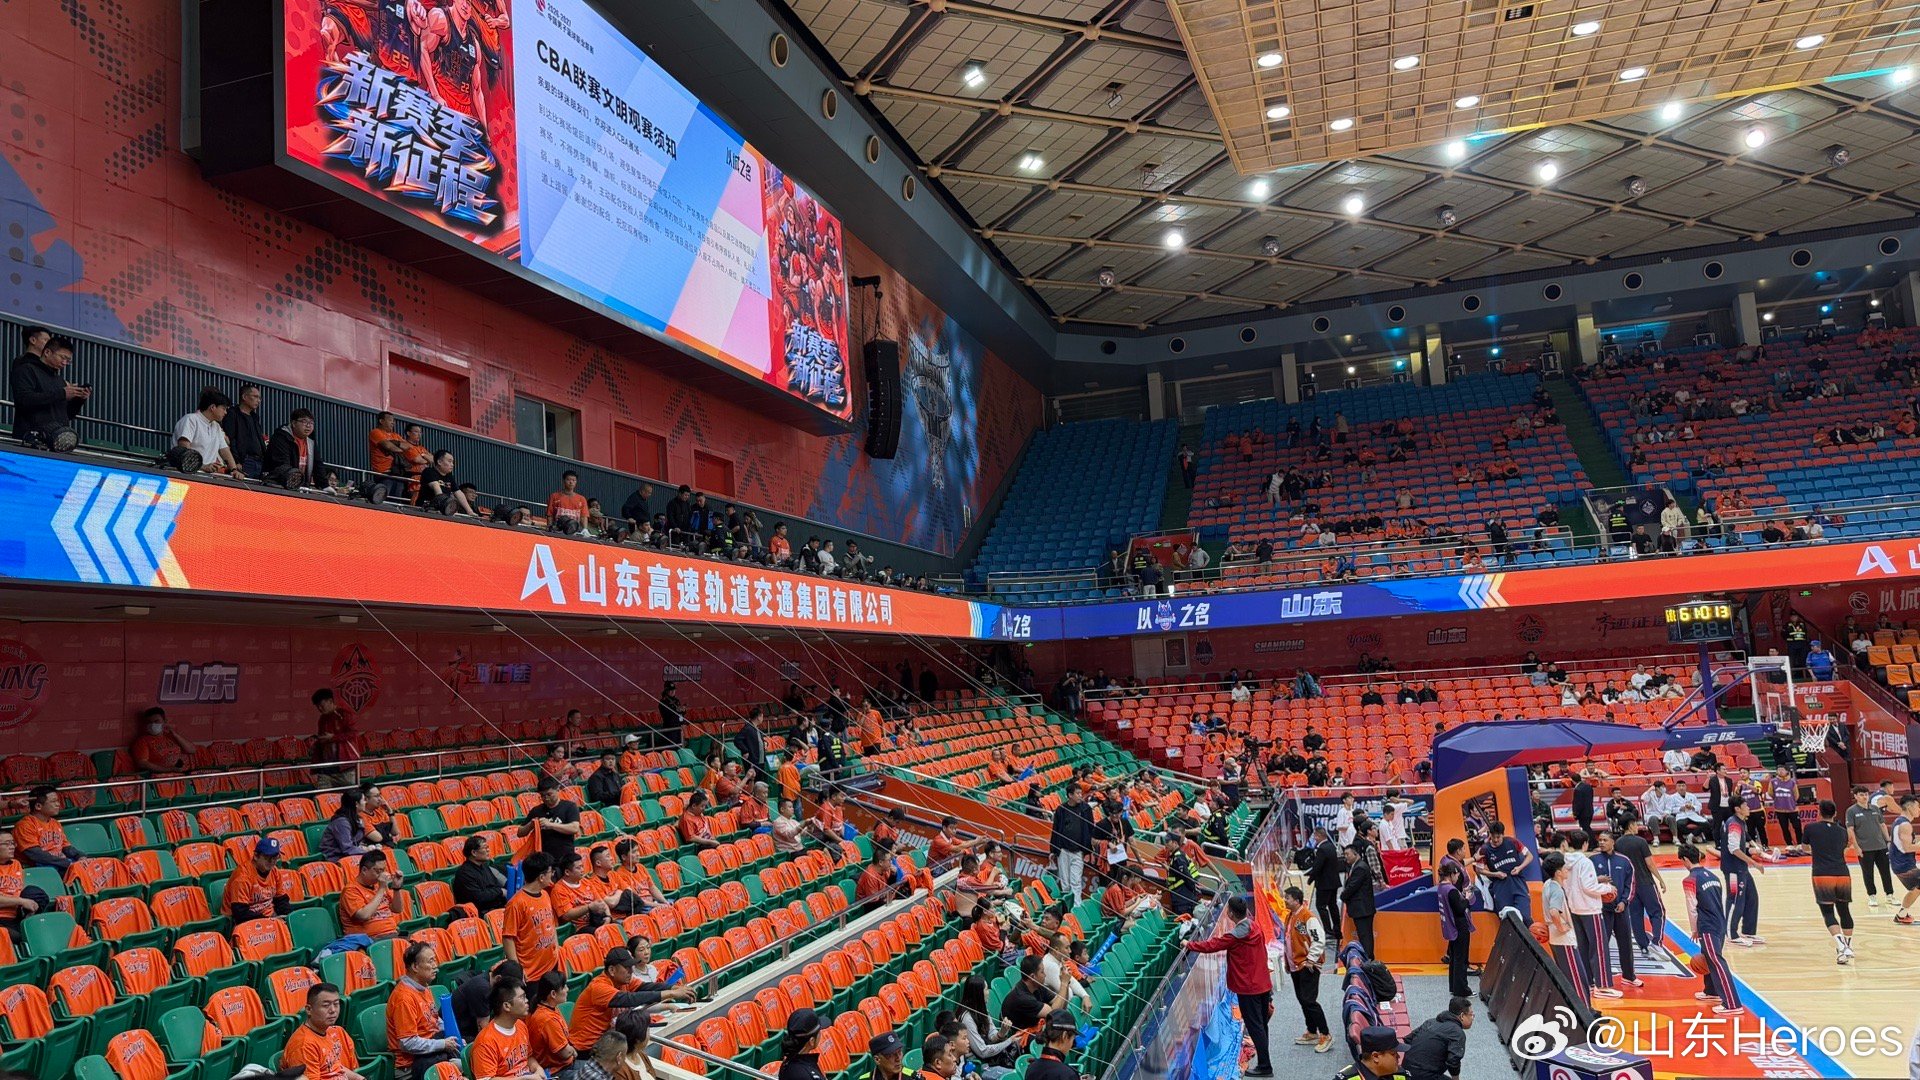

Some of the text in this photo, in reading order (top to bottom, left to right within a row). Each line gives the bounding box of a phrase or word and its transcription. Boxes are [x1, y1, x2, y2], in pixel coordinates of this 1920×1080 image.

[392, 50, 410, 69] 25
[314, 50, 487, 160] 新赛季
[460, 82, 470, 94] 22
[536, 39, 678, 161] CBA联赛文明观赛须知
[320, 110, 498, 226] 新征程
[790, 319, 841, 370] 新赛季
[788, 353, 845, 404] 新征程
[578, 553, 893, 627] 山东高速轨道交通集团有限公司
[1281, 591, 1343, 619] 山东
[1013, 614, 1031, 637] 之名
[1254, 639, 1305, 654] SHANDONG
[159, 663, 239, 702] 山东
[663, 664, 703, 681] SHANDONG
